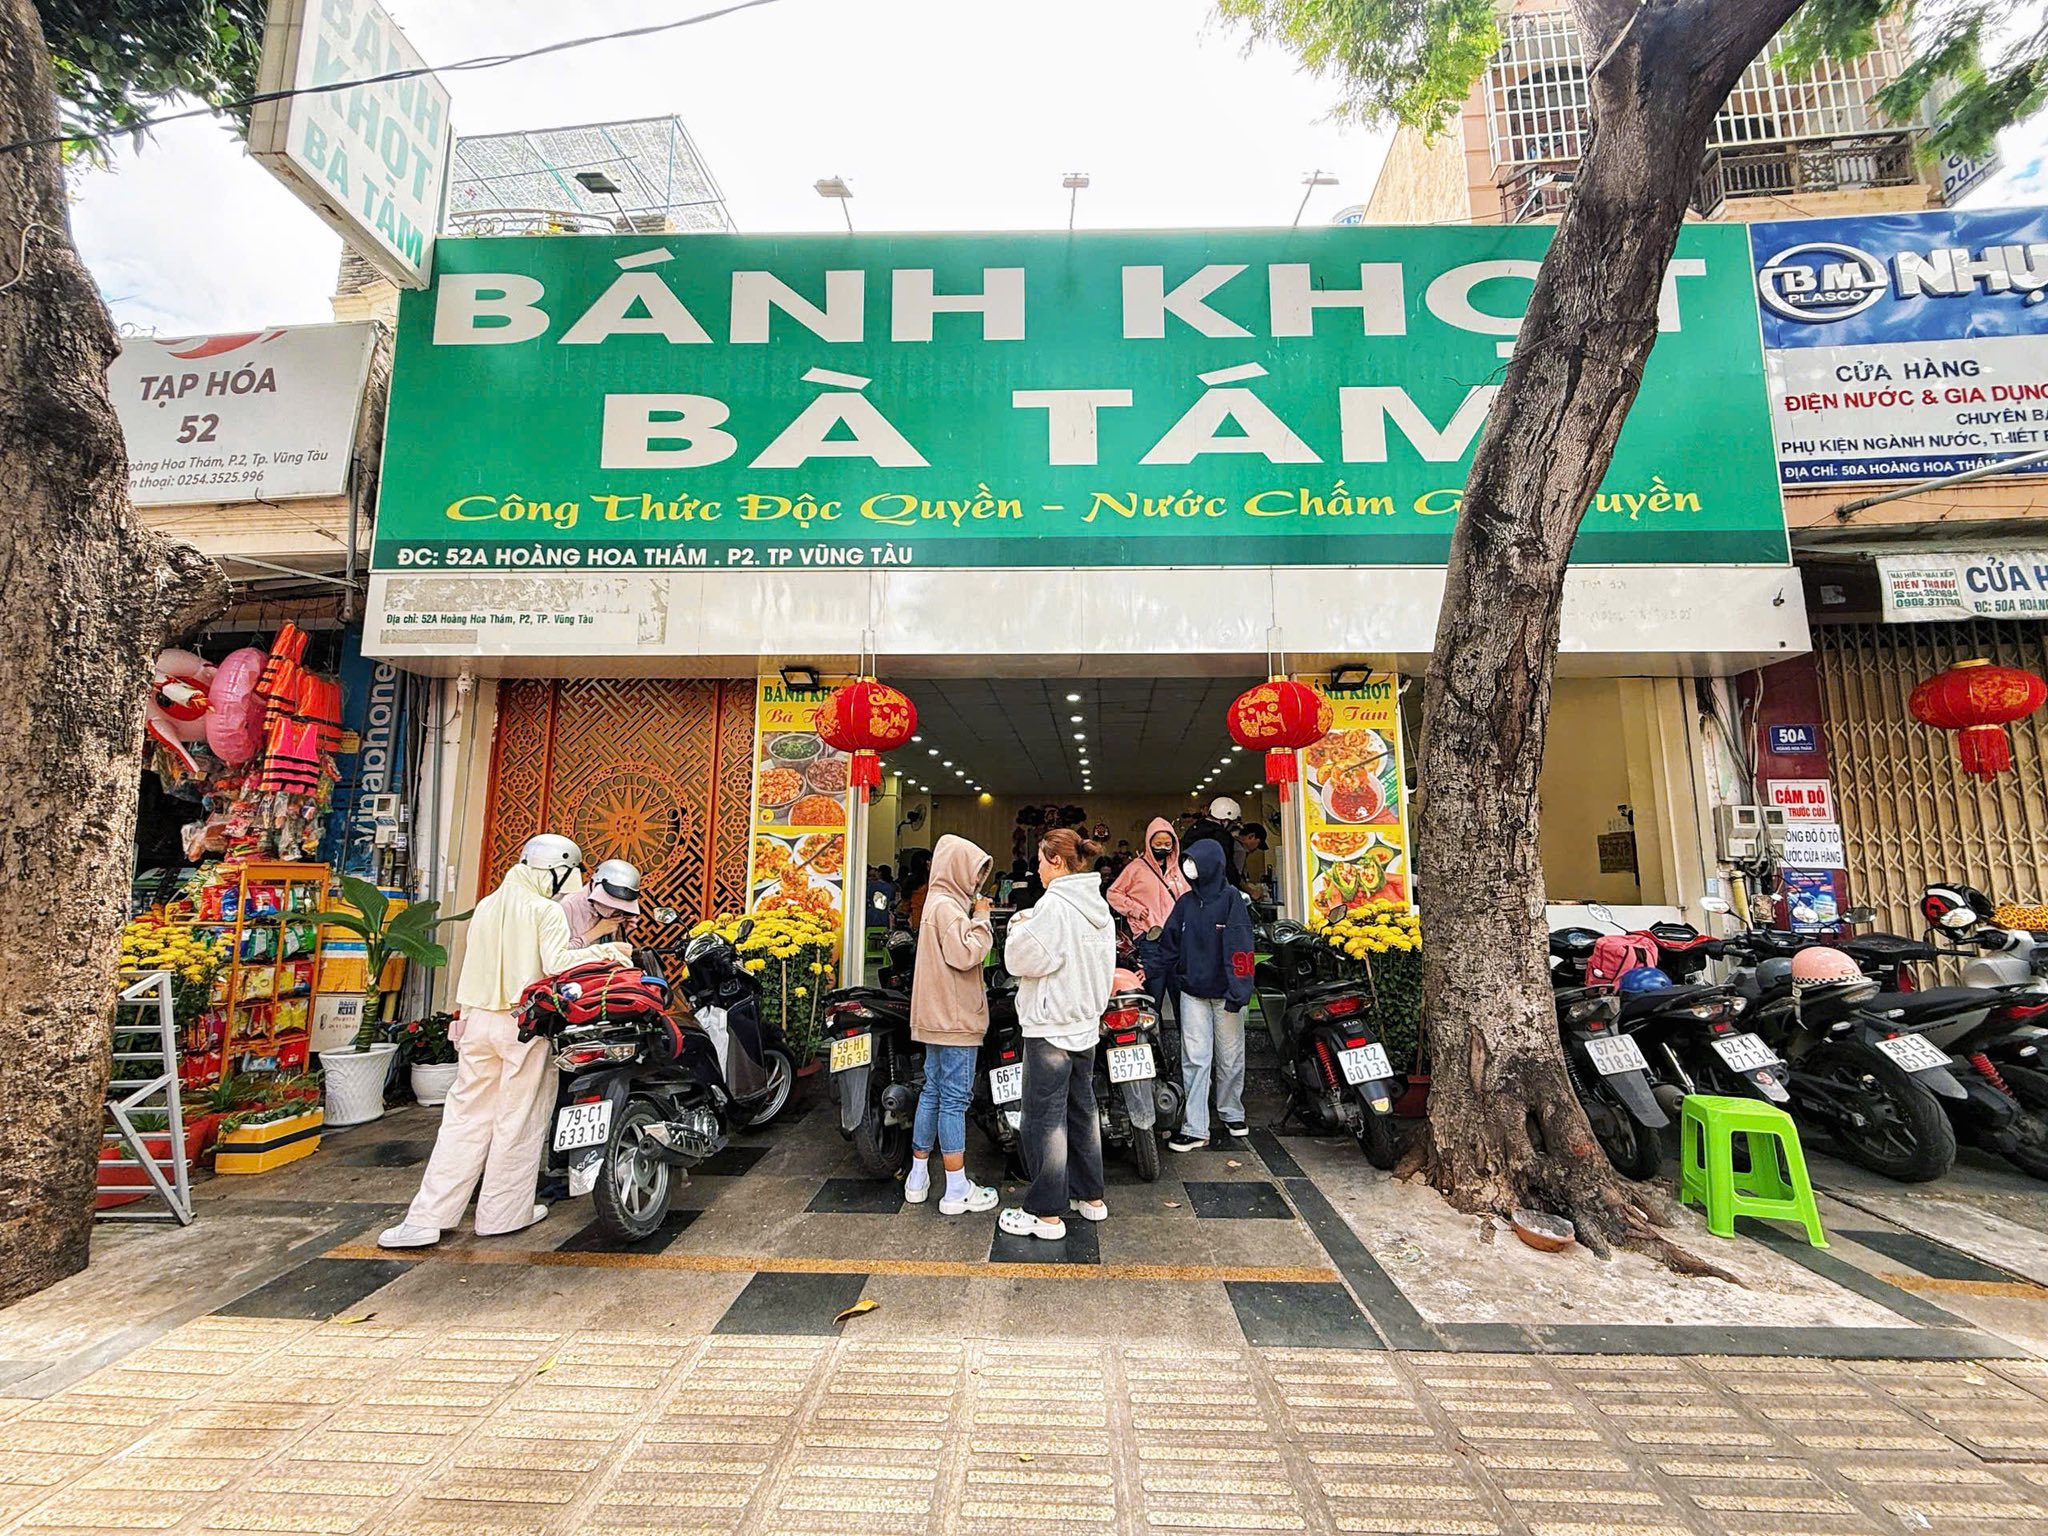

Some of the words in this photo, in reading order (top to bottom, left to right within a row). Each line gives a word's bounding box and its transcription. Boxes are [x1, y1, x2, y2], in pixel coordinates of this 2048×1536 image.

[303, 117, 349, 199] BÀ
[362, 172, 423, 268] TÁM
[432, 247, 1025, 345] BÁNH
[1788, 290, 1865, 304] PLASCO
[1836, 360, 1892, 383] CỬA
[1904, 357, 1980, 381] HÀNG
[140, 373, 199, 408] TẠP
[205, 361, 277, 396] HÓA
[1785, 393, 1838, 414] ĐIỆN
[1843, 388, 1915, 409] NƯỚC
[1922, 389, 1939, 405] &
[1944, 387, 1986, 404] GIA
[600, 366, 931, 470] BÀ
[1012, 362, 1500, 464] TÁM
[1956, 408, 2027, 425] CHUYÊN
[176, 413, 219, 444] 52
[1781, 441, 1815, 456] PHỤ
[1820, 437, 1858, 454] KIỆN
[1863, 434, 1925, 450] NGÀNH
[127, 461, 159, 473] oàng
[161, 459, 185, 470] Hoa
[189, 456, 225, 468] Thám,
[228, 454, 248, 467] P.2,
[252, 453, 268, 467] Tp.
[273, 451, 303, 465] Vũng
[307, 450, 328, 461] Tàu
[1785, 467, 1809, 482] ĐỊA
[1842, 464, 1867, 475] 50A
[1870, 461, 1920, 474] HOÀNG
[1923, 460, 1954, 473] HOA
[139, 475, 175, 491] thoại:
[177, 470, 264, 486] 0254.3525.996
[445, 492, 579, 529] Công
[591, 492, 722, 522] Thức
[737, 493, 842, 530] Độc
[860, 481, 1023, 529] Quyền
[1081, 490, 1227, 523] Nước
[1244, 479, 1396, 516] Chấm
[1594, 475, 1703, 520] uyền
[398, 547, 438, 565] ĐC:
[445, 547, 488, 566] 52A
[495, 543, 581, 566] HOÀNG
[587, 547, 637, 565] HOA
[644, 542, 706, 565] THÁM
[727, 547, 760, 565] P2.
[767, 547, 793, 565] TP
[799, 543, 864, 565] VŨNG
[871, 542, 912, 564] TÀU
[1966, 556, 2032, 593] CỬA
[1995, 599, 2016, 611] 50A
[386, 614, 401, 625] Địa
[403, 613, 419, 625] chỉ:
[421, 614, 437, 625] 52A
[440, 614, 467, 627] Hoàng
[470, 614, 486, 625] Hoa
[490, 613, 516, 626] Thám,
[519, 614, 533, 626] P2,
[537, 614, 550, 625] TP.
[554, 614, 577, 626] Vũng
[578, 614, 594, 624] Tàu
[766, 708, 793, 723] Bà
[1779, 728, 1807, 743] 50A
[1785, 847, 1803, 862] ƯỚC
[837, 1037, 864, 1054] 59-H1
[1113, 1048, 1146, 1063] 59-N3
[1594, 1038, 1630, 1055] 67-L1
[1720, 1037, 1757, 1054] 62-K1
[1884, 1037, 1925, 1055] 59-L3
[1345, 1047, 1380, 1065] 72-C2
[996, 1066, 1022, 1084] 66-F
[1112, 1062, 1152, 1079] 357.79
[1347, 1061, 1390, 1081] 601.33
[566, 1105, 602, 1127] 79-C1
[558, 1123, 606, 1147] 633.18
